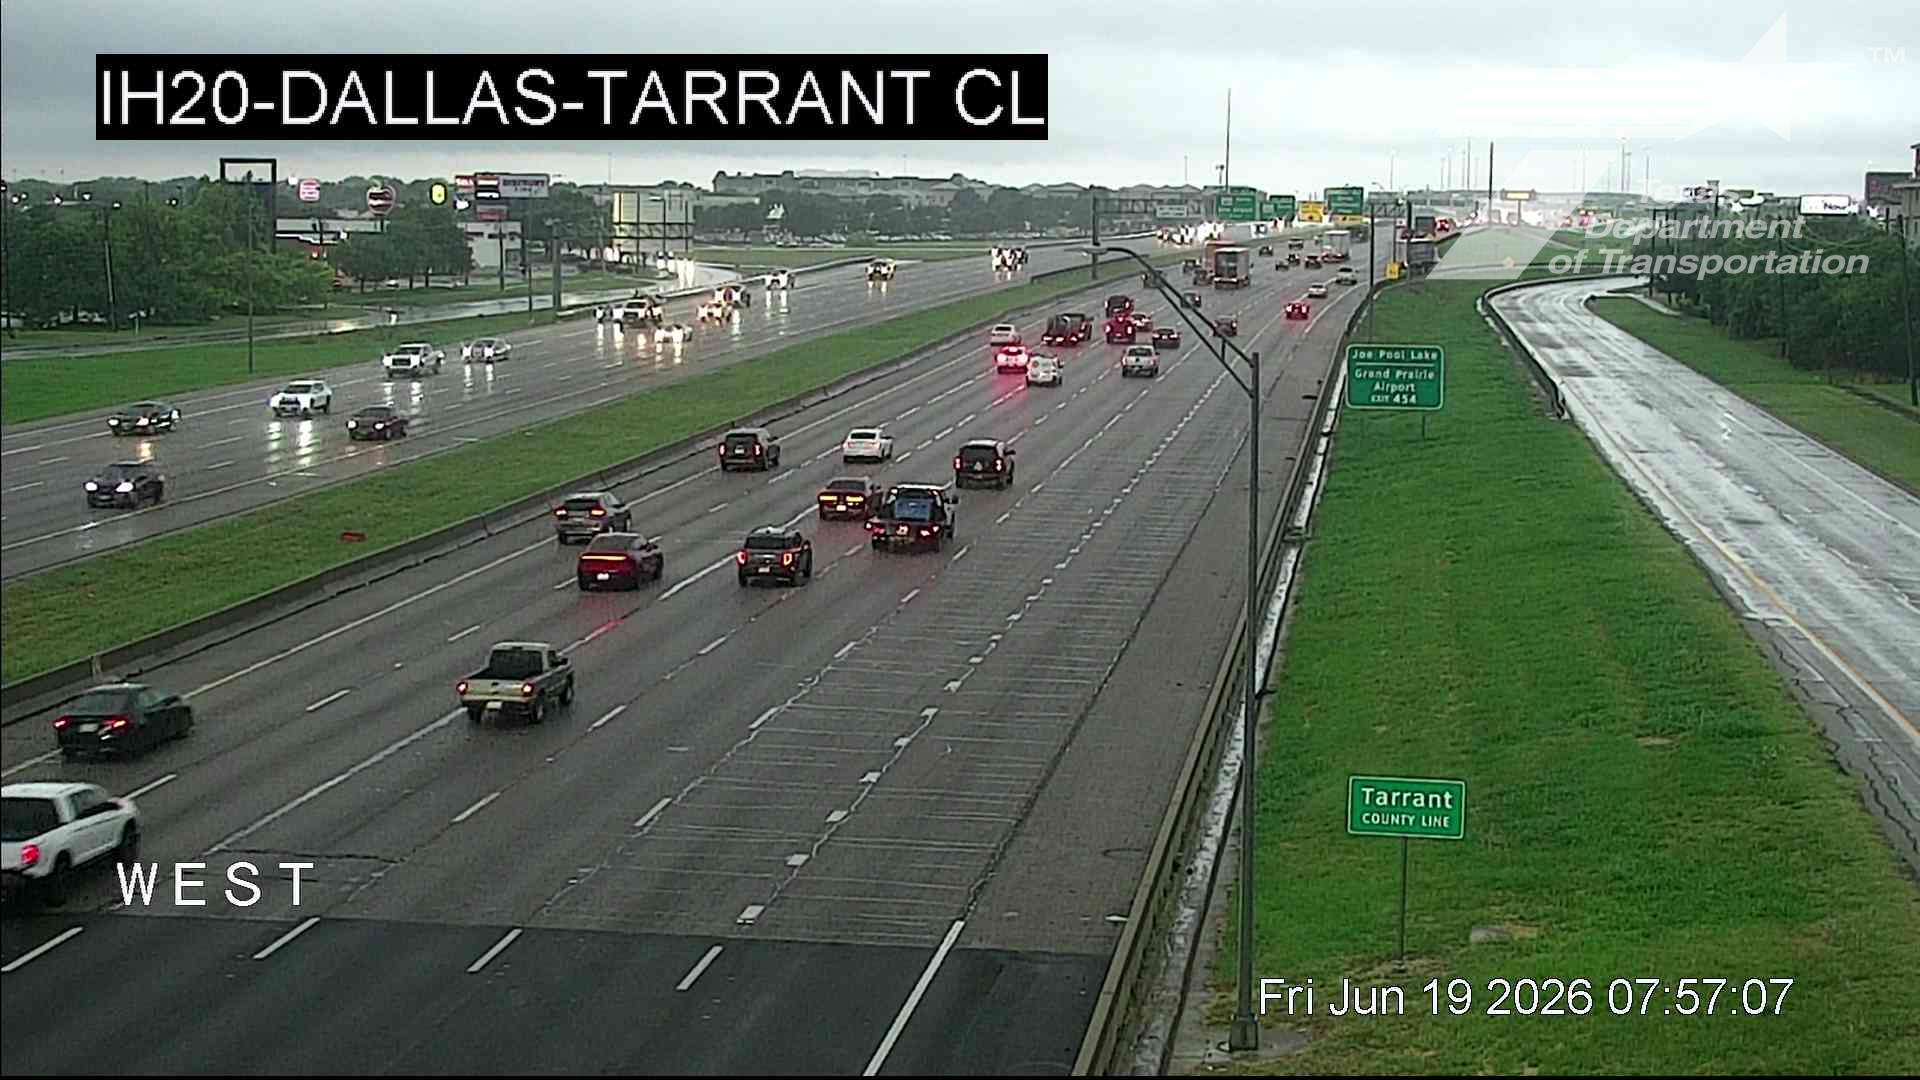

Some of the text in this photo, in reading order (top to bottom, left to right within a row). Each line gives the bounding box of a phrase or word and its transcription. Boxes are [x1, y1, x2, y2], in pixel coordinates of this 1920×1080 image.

[1352, 349, 1438, 360] Joe Pool Lake
[1355, 368, 1435, 380] Grand Prairie
[1373, 381, 1415, 394] Airport
[1393, 394, 1417, 404] 454
[1361, 787, 1453, 809] Tarrant
[1362, 812, 1450, 828] COUNTY LINE
